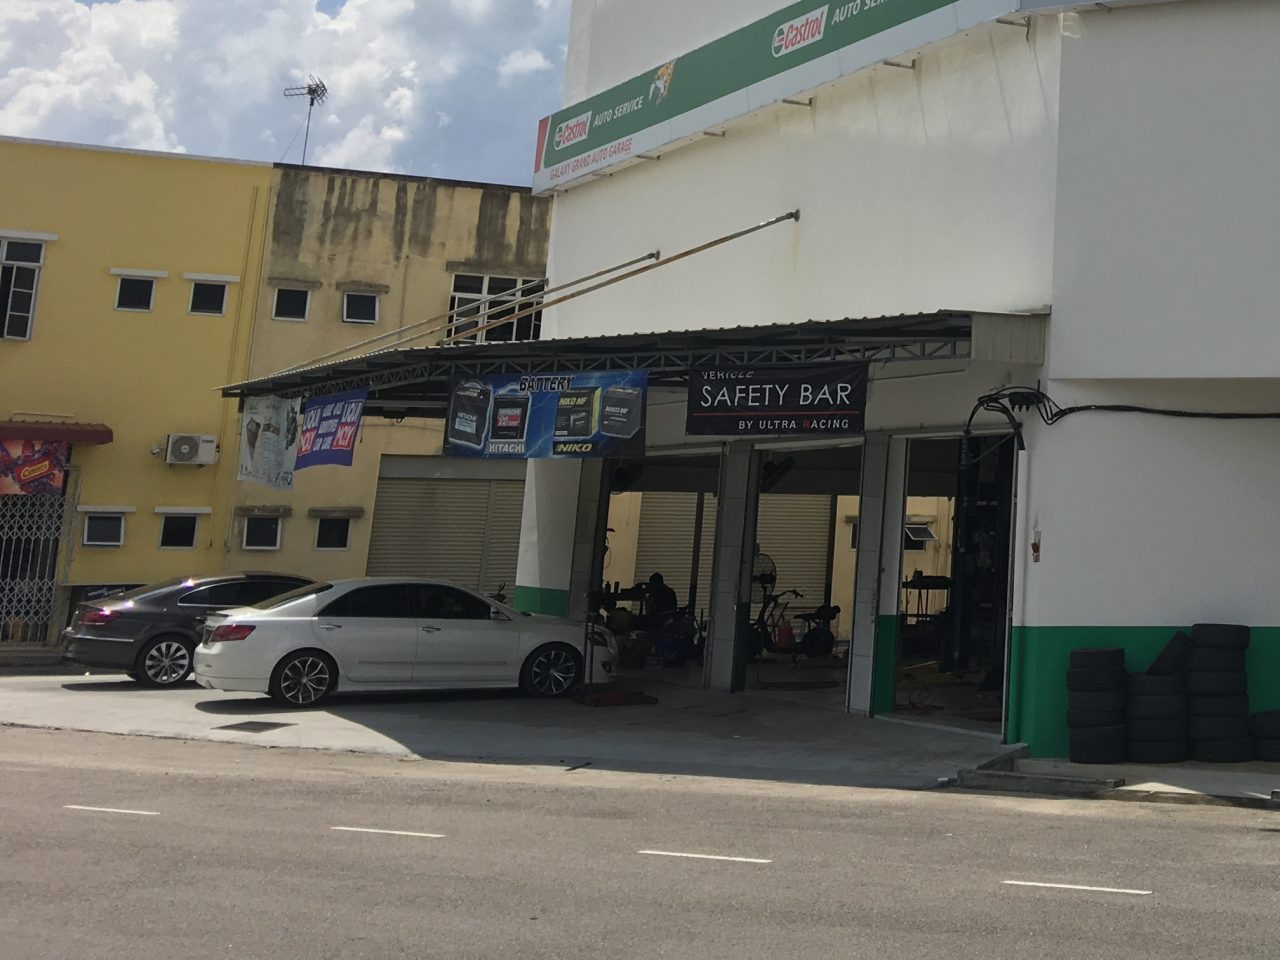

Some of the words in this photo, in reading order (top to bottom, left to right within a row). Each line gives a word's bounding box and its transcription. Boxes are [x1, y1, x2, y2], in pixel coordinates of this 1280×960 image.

[783, 10, 825, 50] Castrol
[831, 0, 861, 25] AUTO
[562, 115, 589, 144] Castrol
[592, 109, 613, 127] AUTO
[613, 96, 644, 119] SERVICE
[550, 163, 571, 180] GALAXY
[571, 155, 591, 171] GRAND
[591, 147, 608, 165] AUTO
[608, 138, 633, 158] GARAGE
[519, 376, 575, 393] BATTERY
[701, 384, 789, 407] SAFETY
[800, 383, 852, 406] BAR
[738, 420, 754, 429] BY
[759, 420, 797, 429] ULTRA
[803, 419, 849, 429] RACING
[488, 443, 526, 454] HITACHI
[556, 443, 593, 453] NIKO
